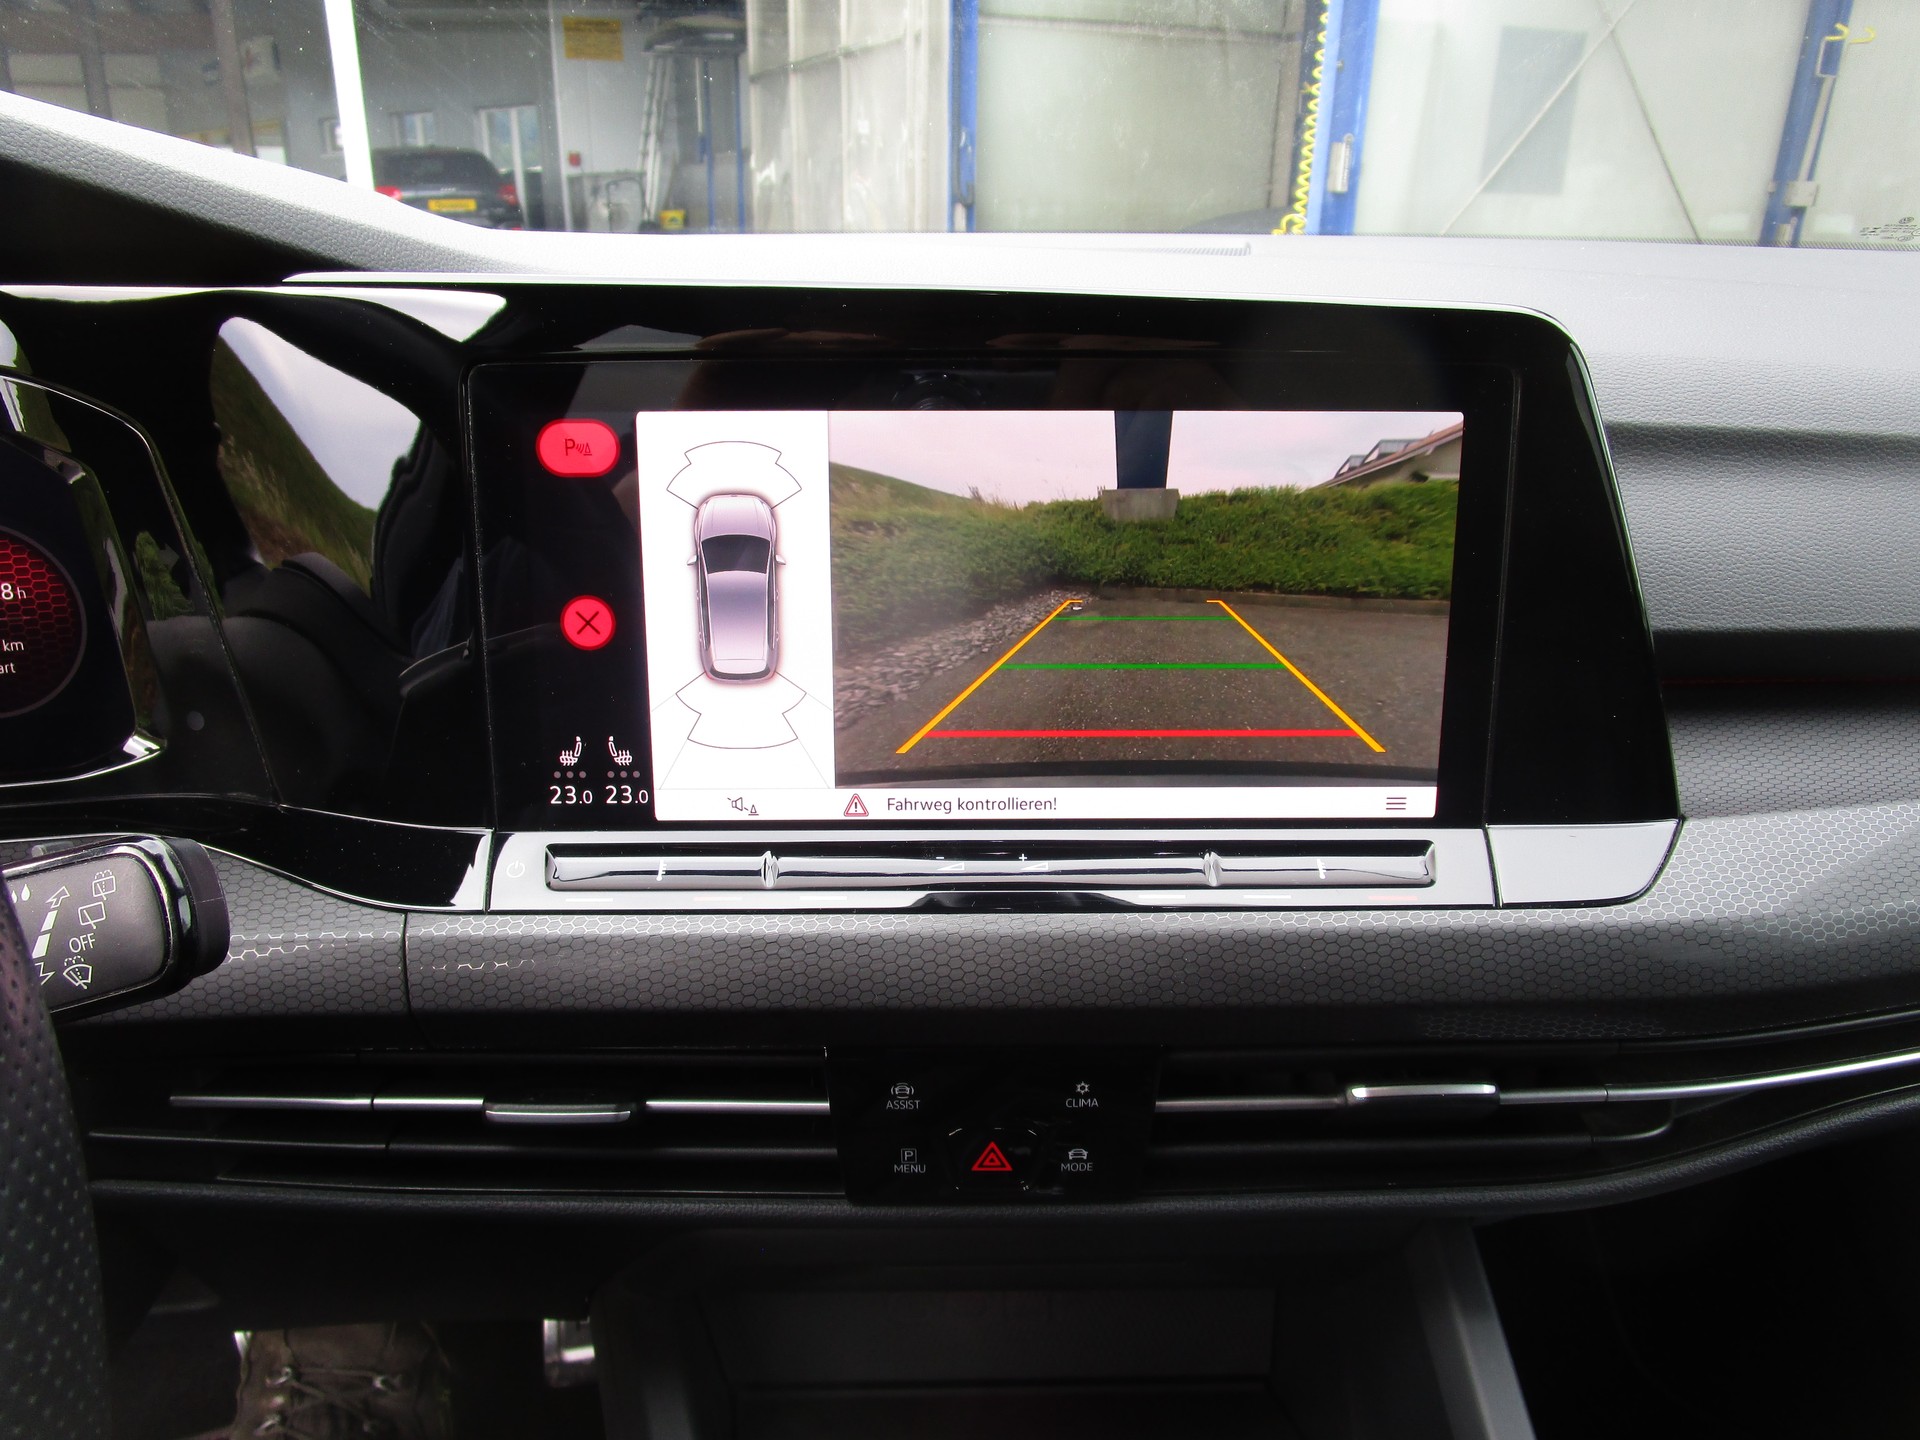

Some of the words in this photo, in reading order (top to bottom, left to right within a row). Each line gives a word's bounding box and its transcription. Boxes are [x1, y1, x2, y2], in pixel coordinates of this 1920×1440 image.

[17, 586, 27, 599] h
[2, 639, 25, 652] km
[549, 785, 593, 805] 23.0
[605, 784, 649, 804] 23.0
[887, 797, 952, 814] Fahrweg
[957, 797, 1057, 811] kontrollieren!
[68, 932, 96, 953] OFF
[886, 1100, 920, 1110] ASSIST
[1065, 1098, 1099, 1108] CLIMA
[904, 1150, 914, 1161] P
[893, 1164, 926, 1174] MENU
[1060, 1162, 1093, 1172] MODE
